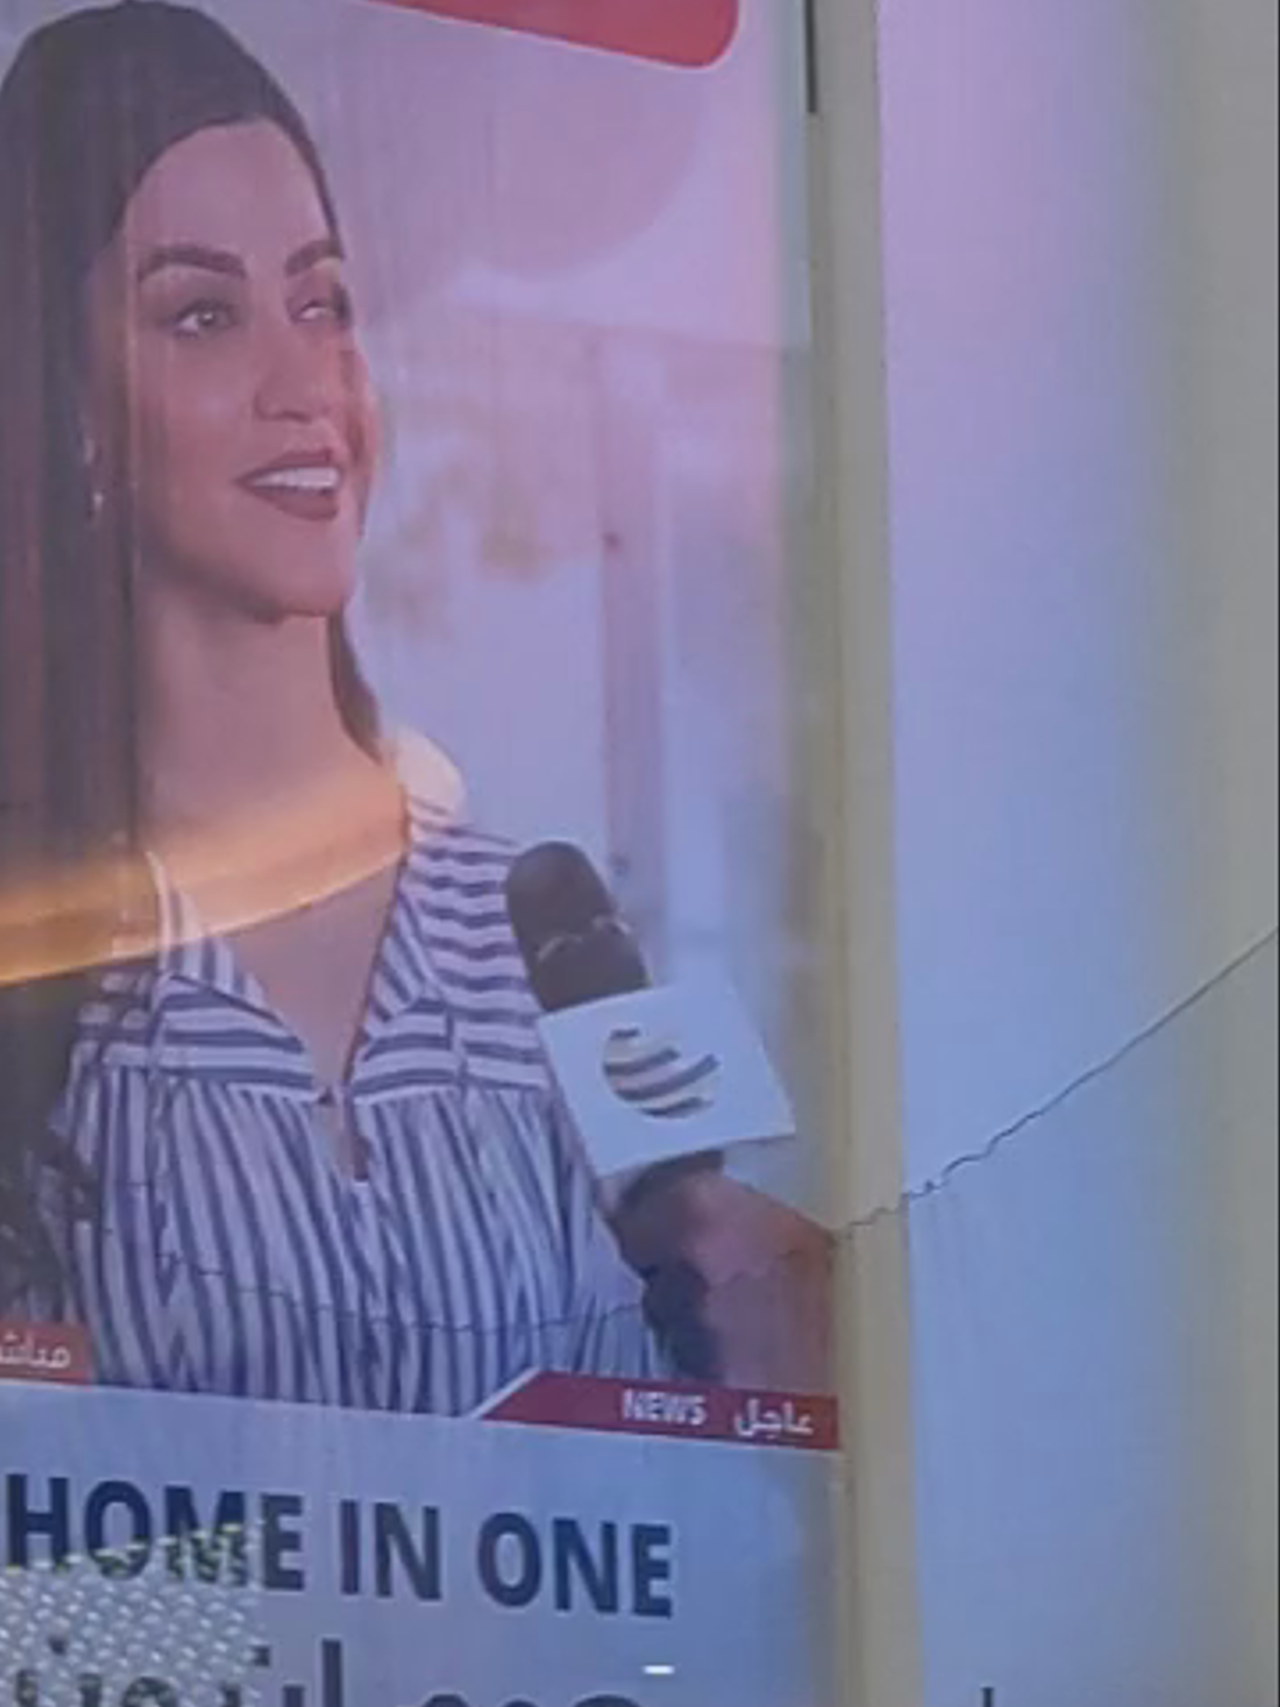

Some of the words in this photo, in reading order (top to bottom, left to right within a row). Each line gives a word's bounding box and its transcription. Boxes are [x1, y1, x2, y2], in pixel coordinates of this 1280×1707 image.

[623, 1388, 707, 1425] NEWS
[735, 1397, 814, 1440] عاجل
[4, 1473, 305, 1592] HOME
[340, 1499, 442, 1600] IN
[476, 1511, 675, 1618] ONE
